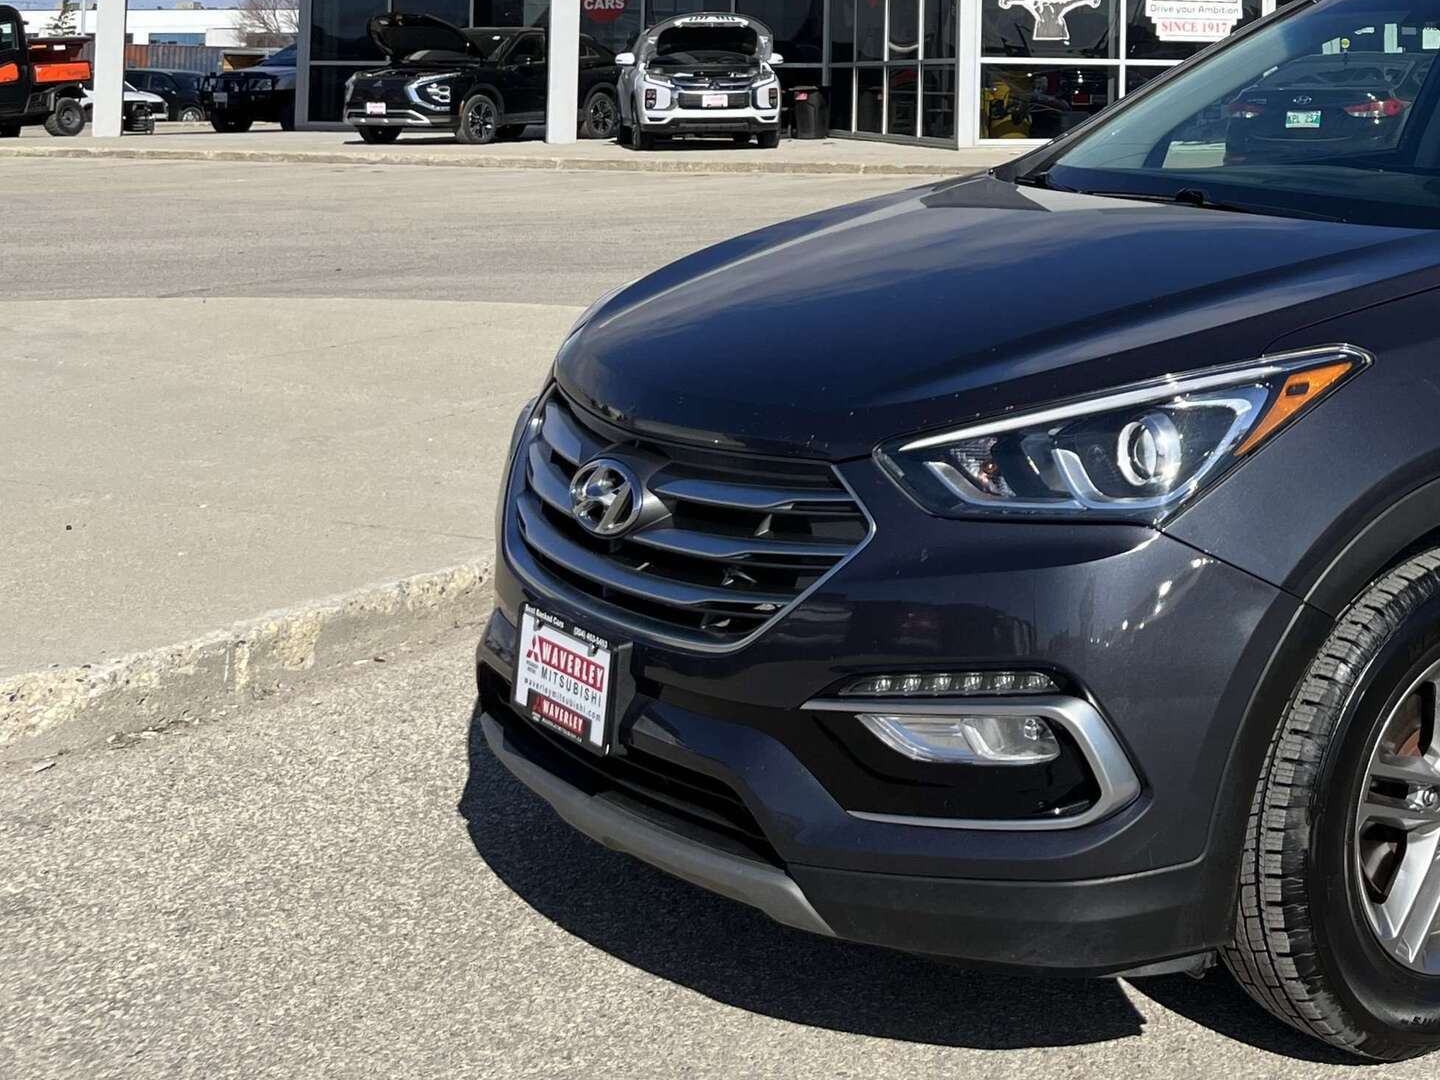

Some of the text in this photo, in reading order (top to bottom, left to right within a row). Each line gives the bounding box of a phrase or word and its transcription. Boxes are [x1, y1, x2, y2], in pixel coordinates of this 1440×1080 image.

[1151, 4, 1239, 14] Drive your Ambition
[1161, 22, 1227, 33] SINCE 1917
[552, 617, 564, 628] Cars
[542, 641, 604, 688] WAVERLEY
[541, 666, 602, 707] MITSUBISHI
[543, 699, 583, 732] WAVERLEY
